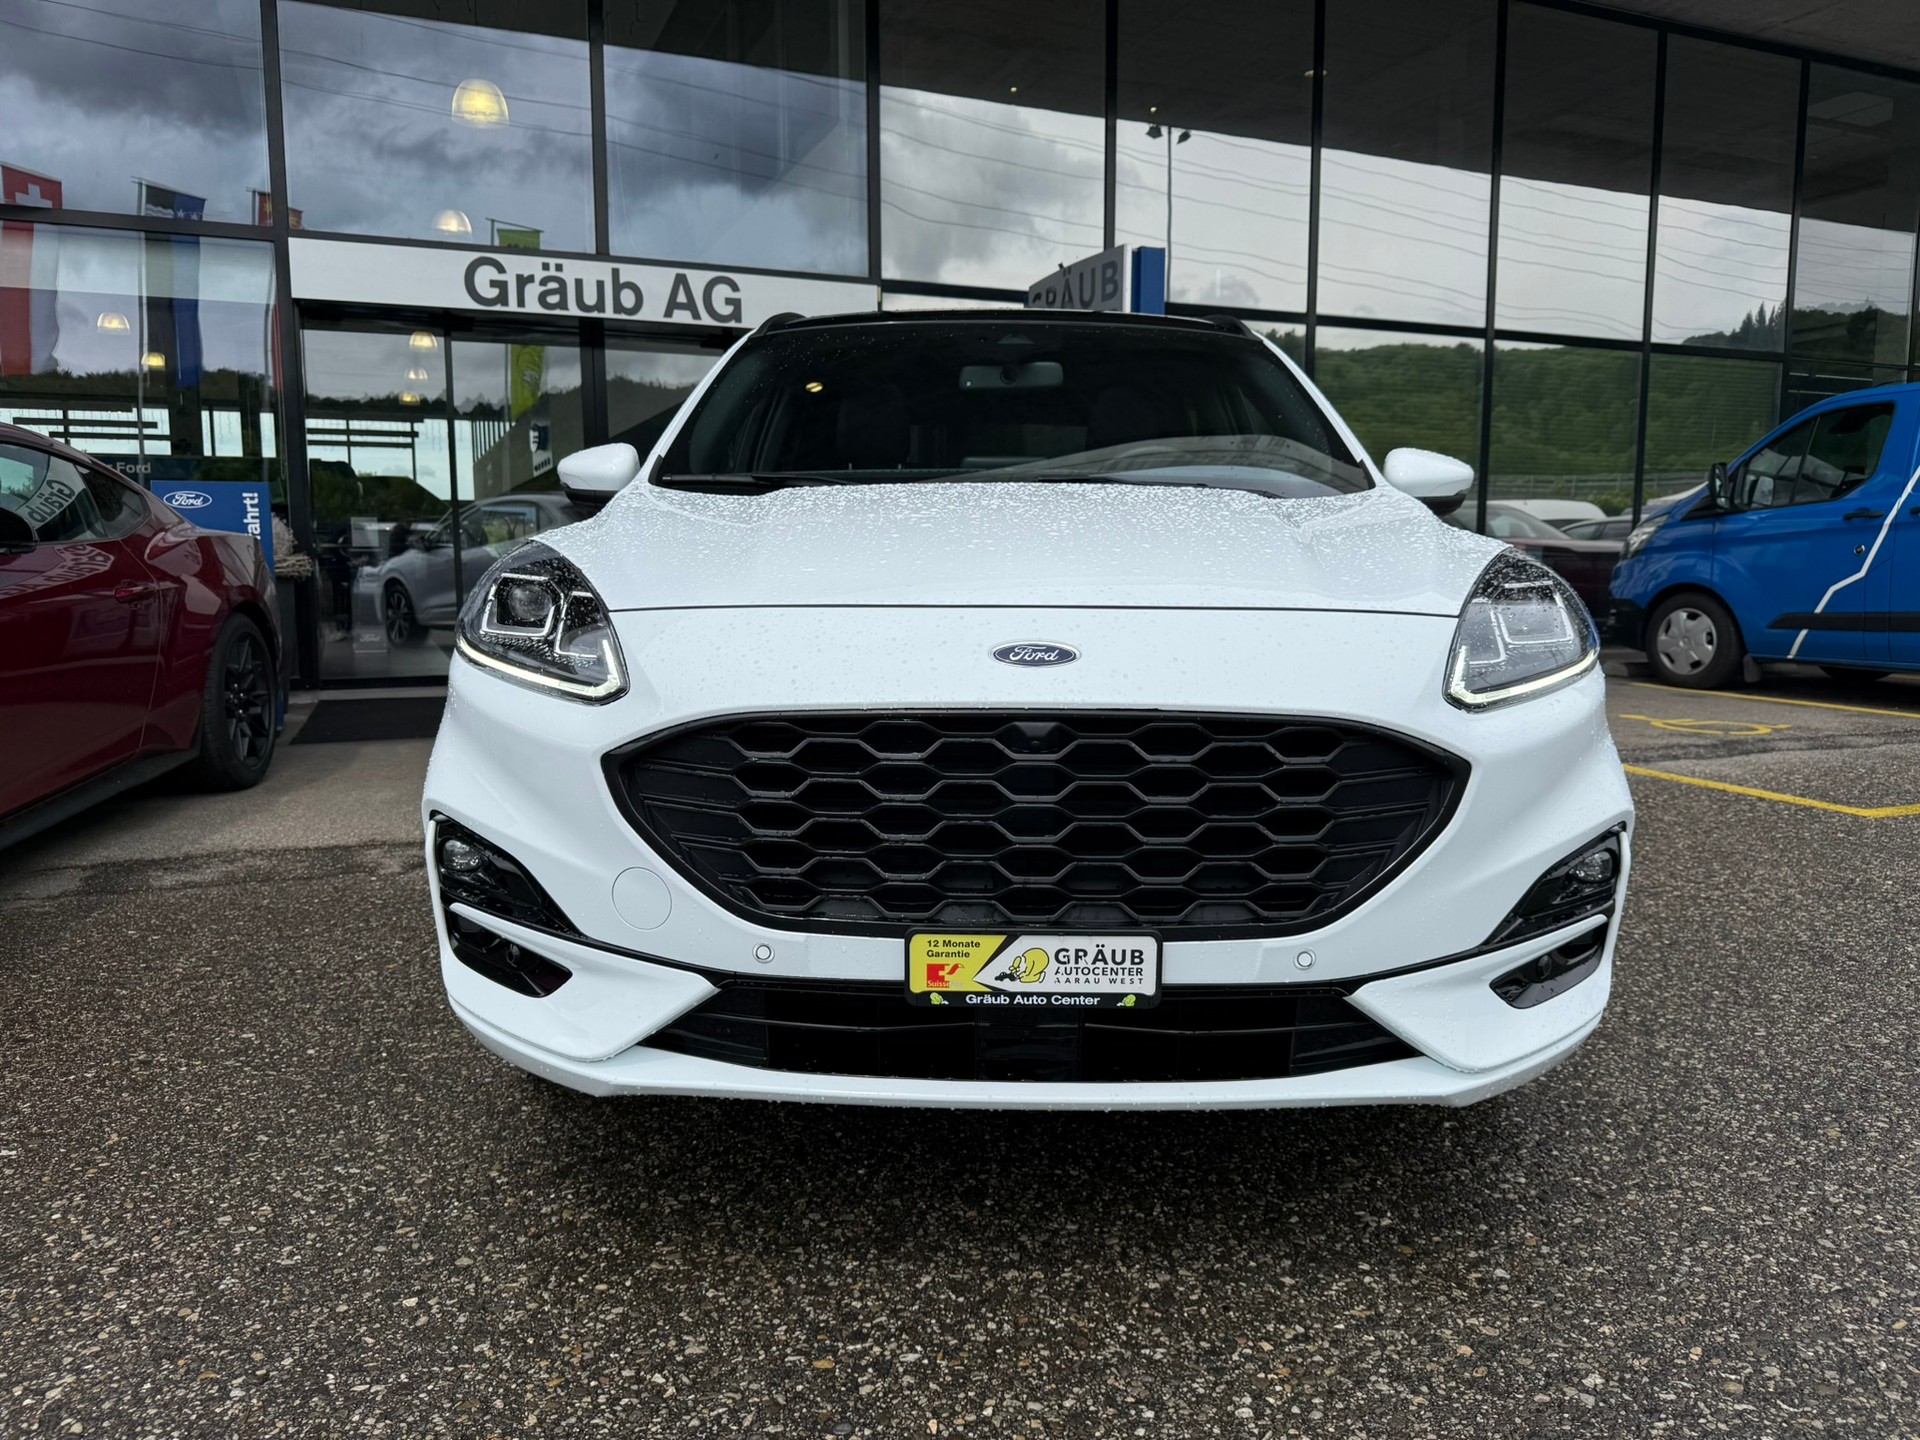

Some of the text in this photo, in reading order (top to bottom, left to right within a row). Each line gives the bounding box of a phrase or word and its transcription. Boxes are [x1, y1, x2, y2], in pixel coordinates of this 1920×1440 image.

[464, 256, 742, 323] Gräub AG
[116, 462, 151, 474] Ford
[172, 493, 203, 506] Ford
[242, 492, 261, 540] ahrt!
[1009, 645, 1059, 661] Ford
[927, 940, 981, 948] 12 Monate
[926, 949, 970, 958] Garantie
[1054, 944, 1144, 966] GRÄUB
[1054, 966, 1144, 977] AUTOCENTER
[1054, 977, 1144, 985] AARAU WEST
[965, 994, 1100, 1006] Gräub Auto Center
